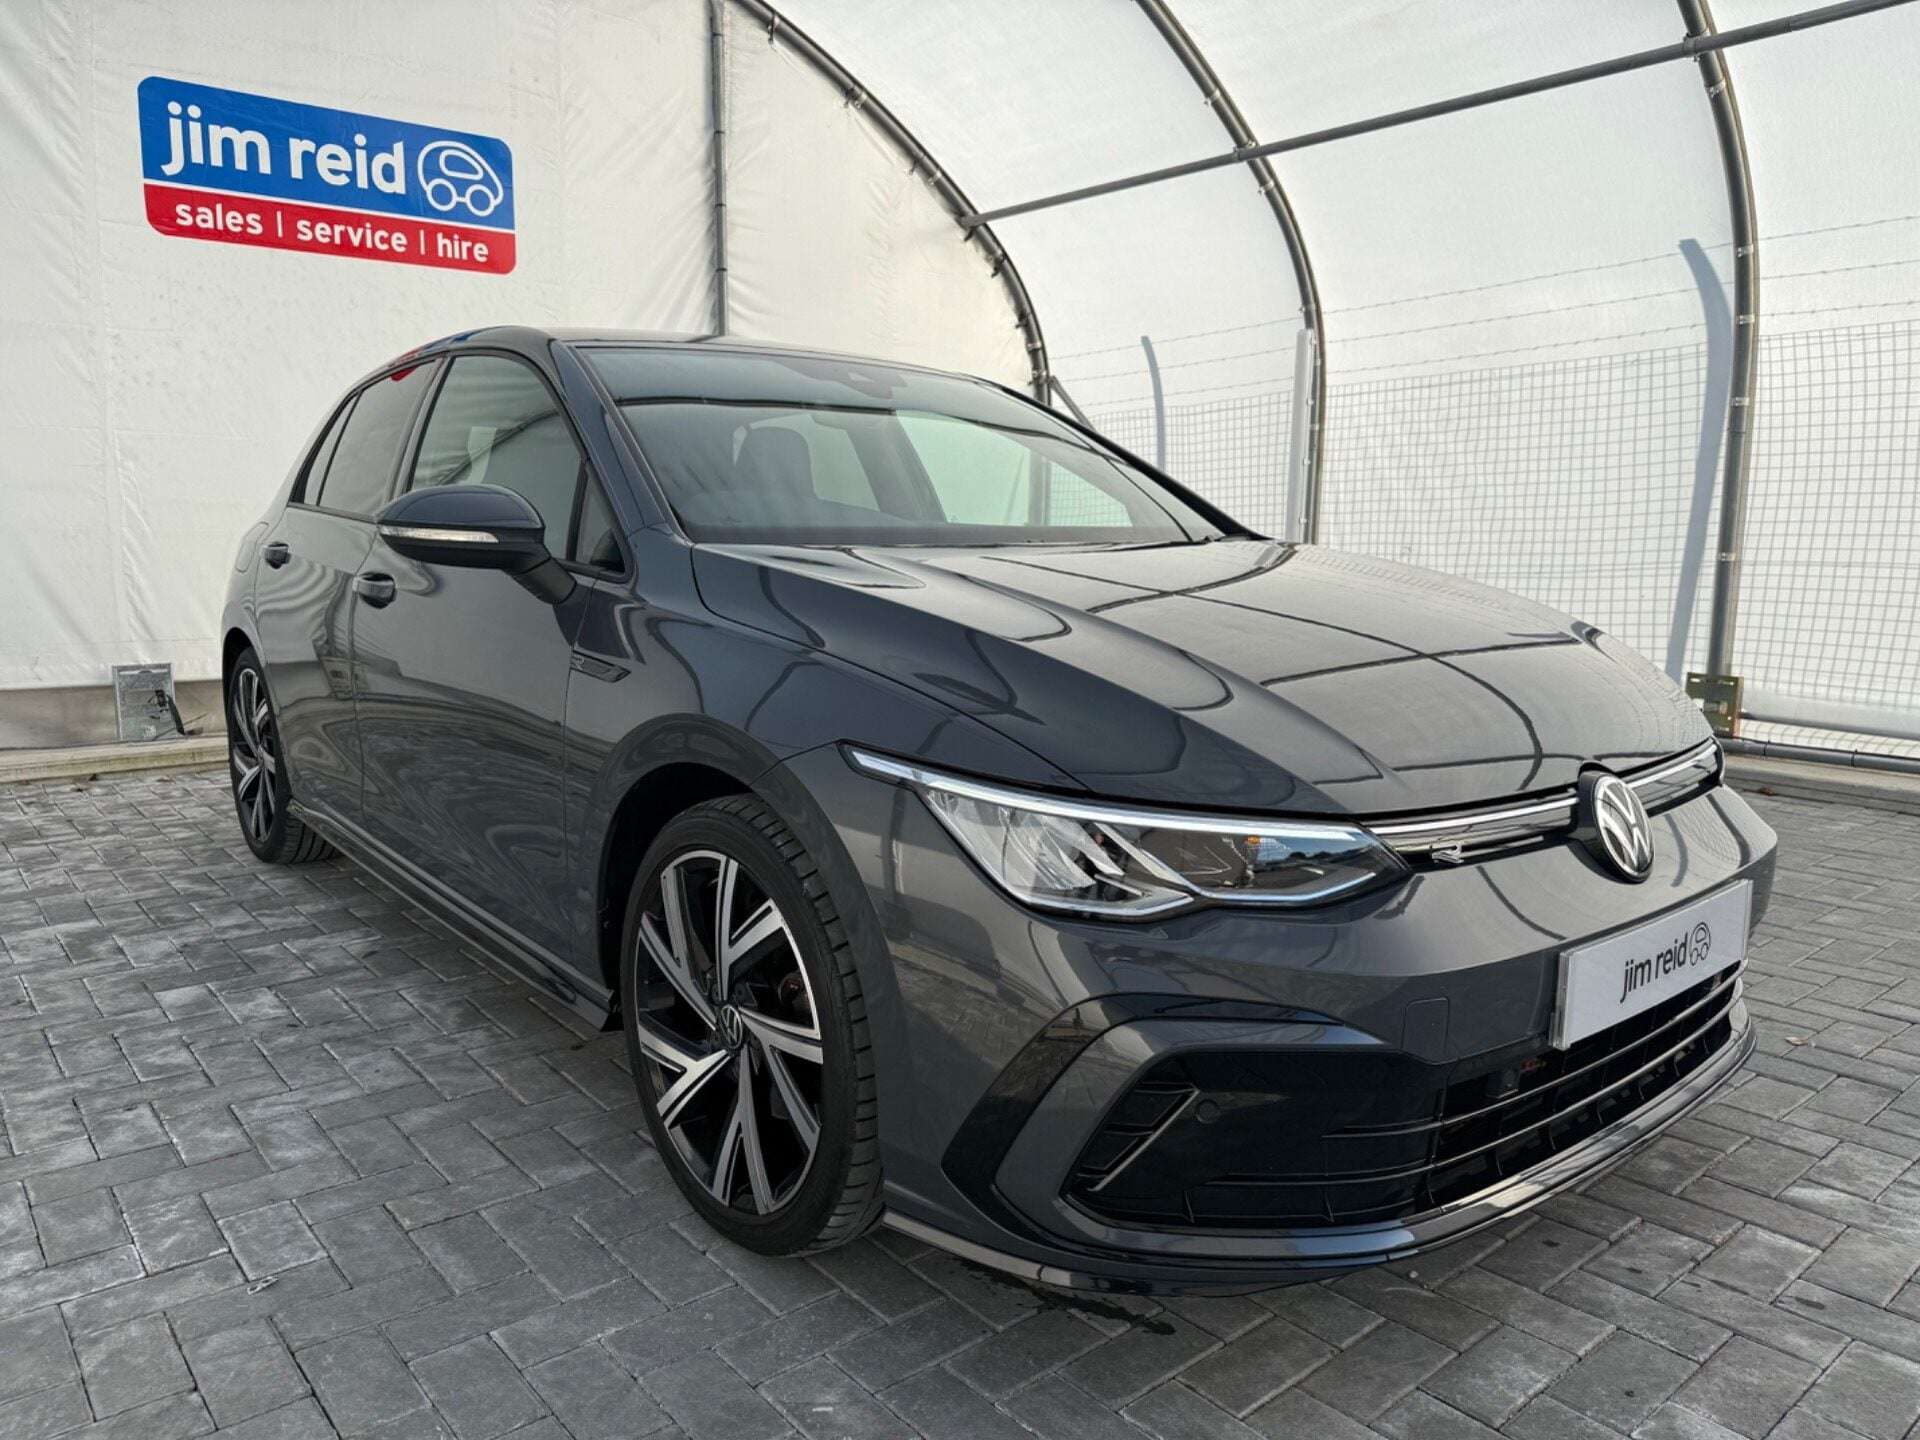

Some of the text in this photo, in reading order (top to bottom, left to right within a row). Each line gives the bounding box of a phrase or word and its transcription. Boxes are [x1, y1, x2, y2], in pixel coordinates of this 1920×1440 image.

[161, 101, 407, 195] jim reid
[175, 203, 489, 262] sales service hire
[1620, 932, 1688, 1003] jim reid
